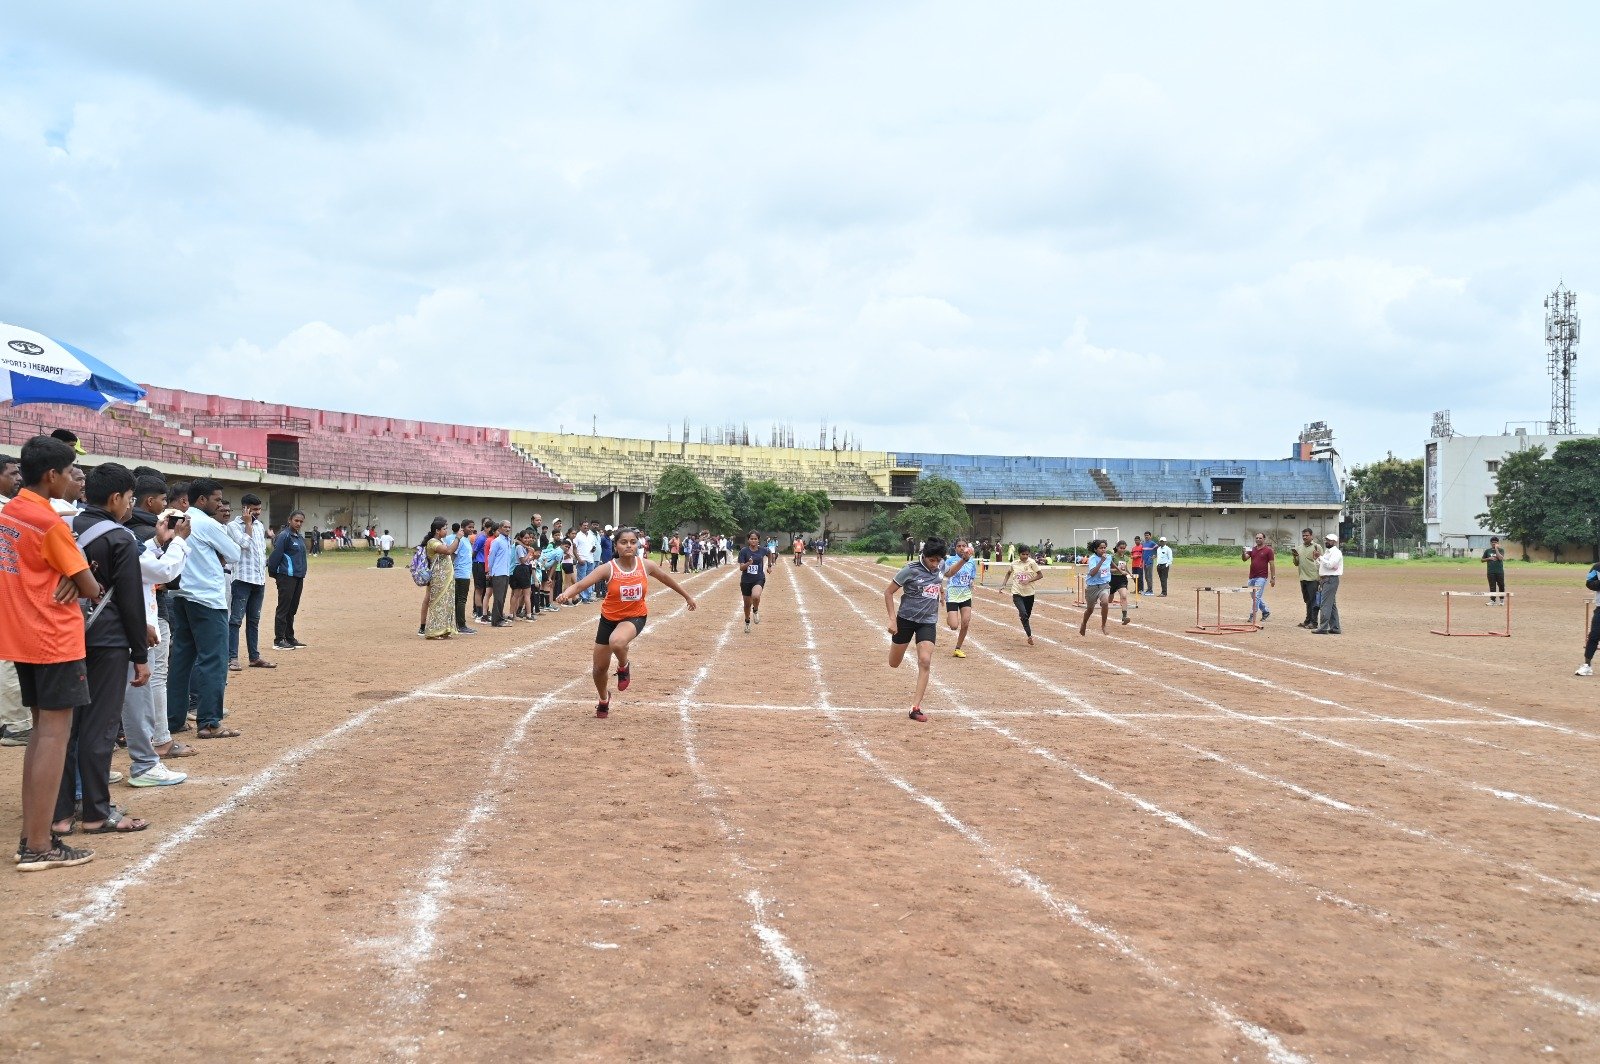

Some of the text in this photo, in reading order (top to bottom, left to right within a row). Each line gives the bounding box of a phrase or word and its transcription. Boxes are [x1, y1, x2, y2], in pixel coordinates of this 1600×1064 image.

[1, 358, 64, 376] SPORTS THERAPIST
[622, 587, 640, 597] 281
